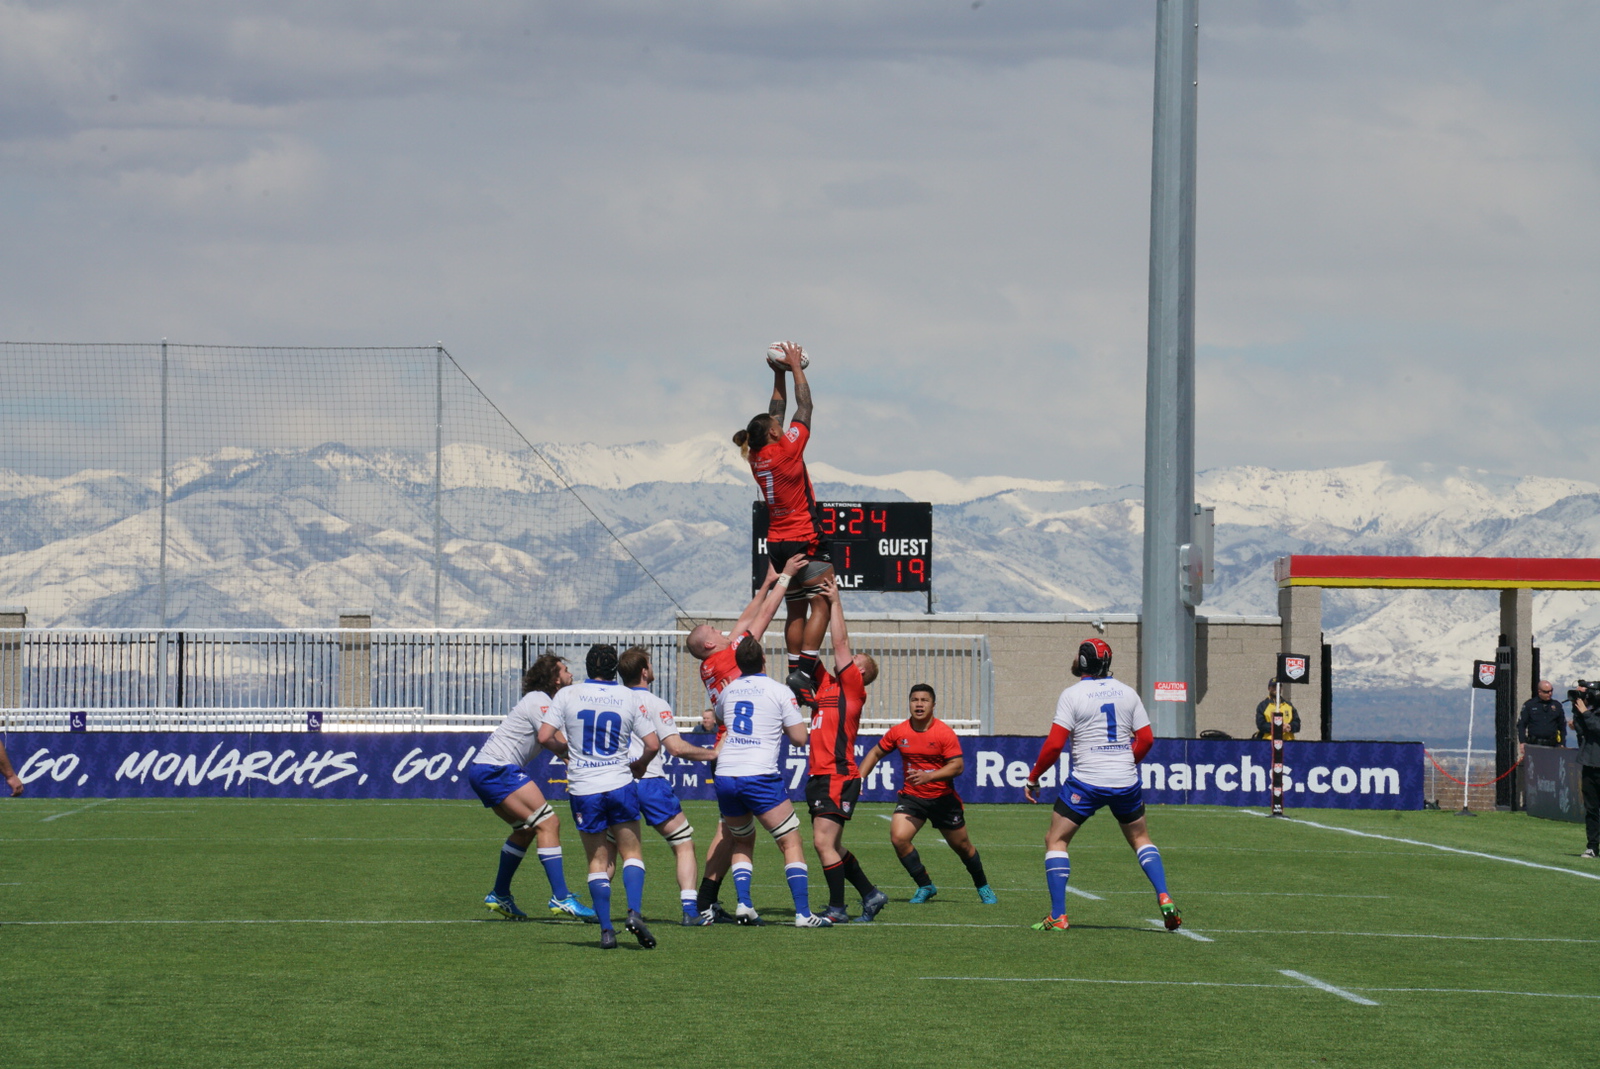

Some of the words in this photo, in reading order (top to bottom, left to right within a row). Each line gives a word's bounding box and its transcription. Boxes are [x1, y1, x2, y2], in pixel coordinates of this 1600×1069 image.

[878, 538, 929, 556] GUEST
[897, 558, 924, 583] 19
[834, 574, 864, 588] ALF
[1287, 659, 1303, 667] MLR
[729, 686, 765, 695] WAYPOINT
[1087, 688, 1124, 699] WAYPOINT
[1157, 682, 1185, 690] CAUTION
[579, 695, 624, 706] WAYPOINT
[732, 700, 754, 736] 8
[1100, 703, 1117, 743] 1
[577, 709, 622, 757] 10
[18, 747, 89, 786] GO,
[115, 741, 369, 790] MONARCHS,
[392, 746, 476, 784] GO!
[976, 751, 1400, 795] Realnarchs.com
